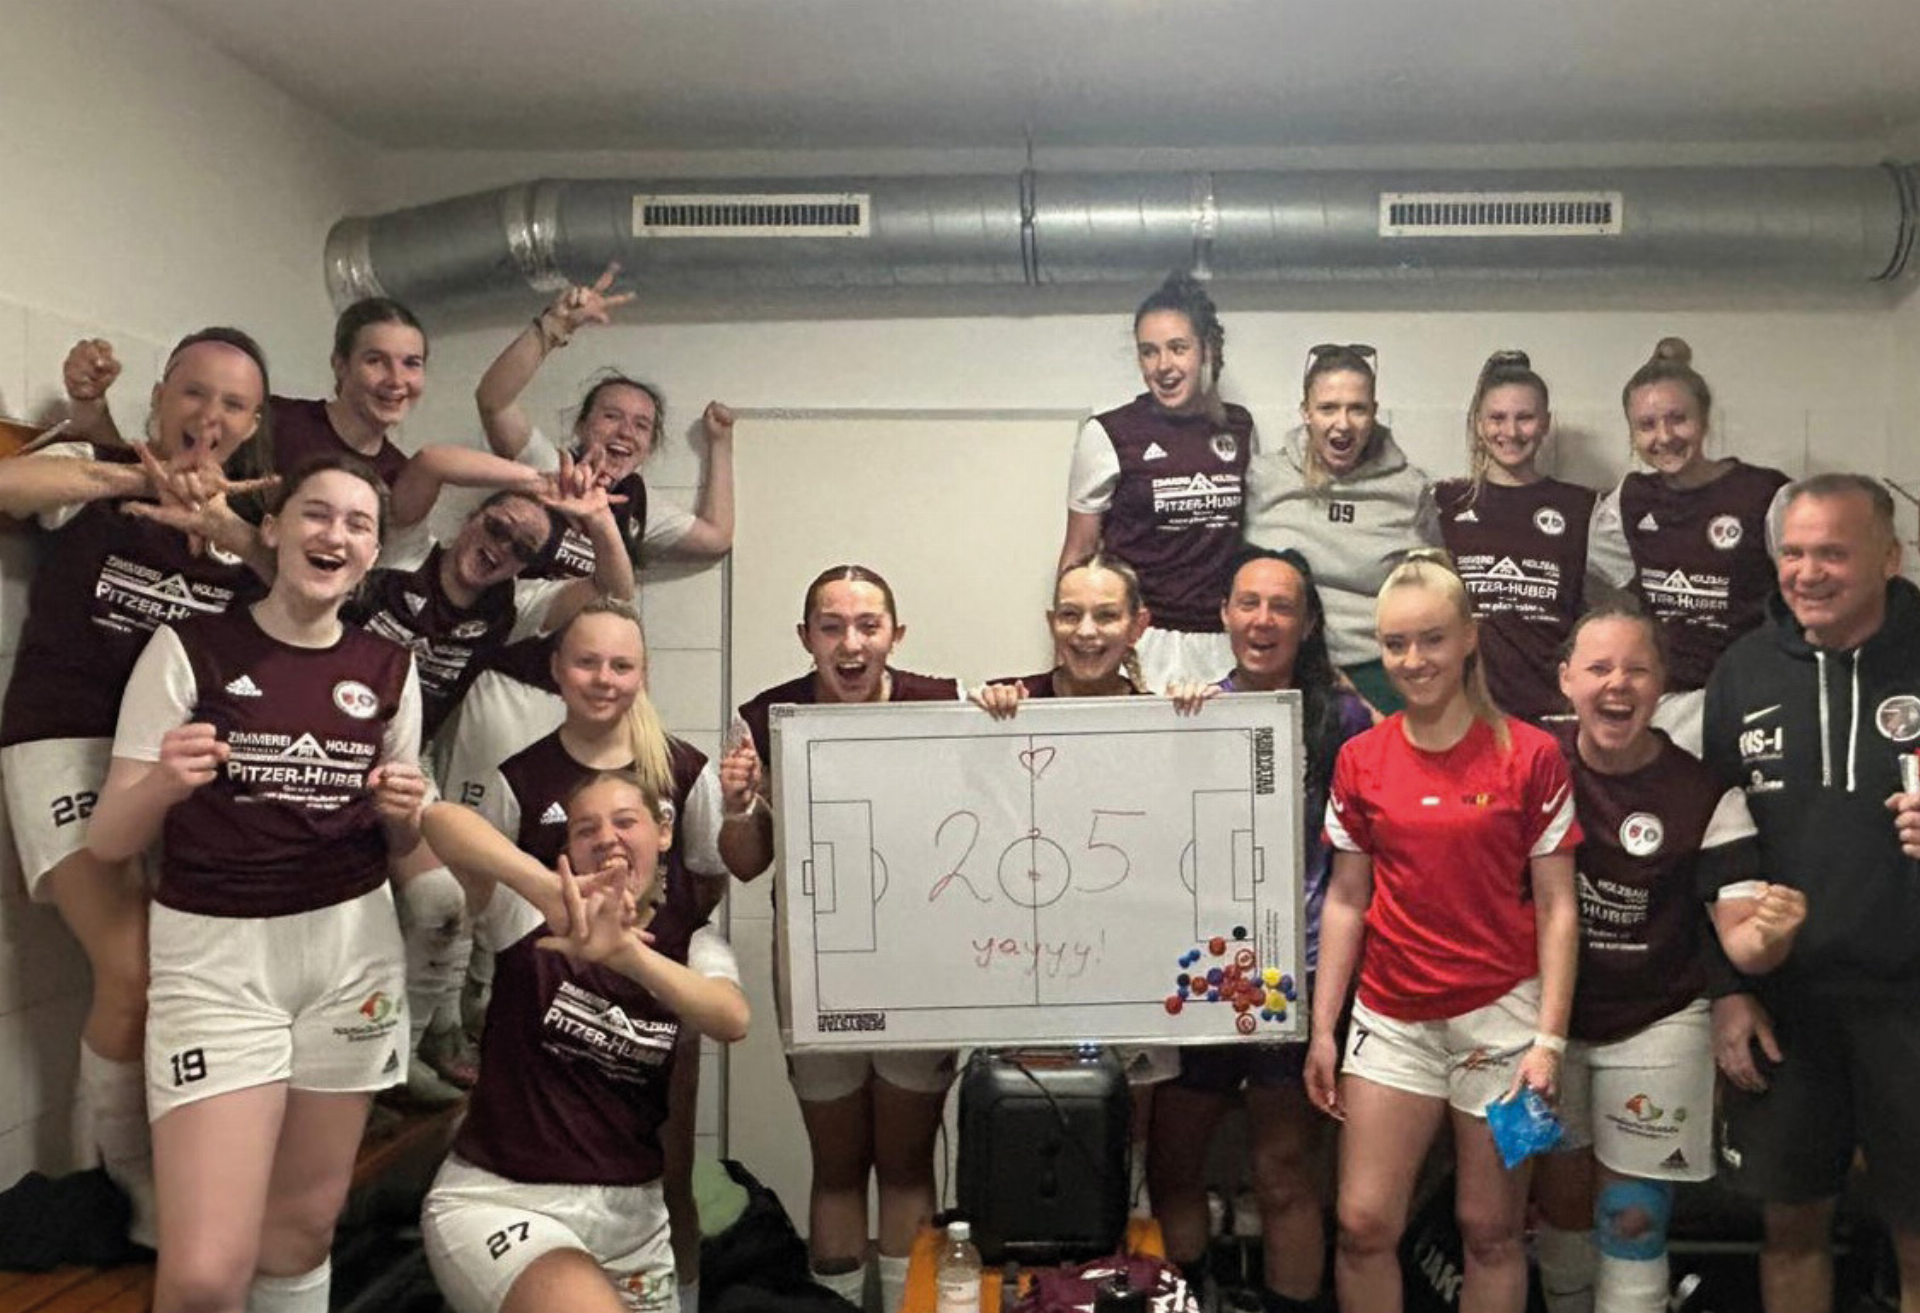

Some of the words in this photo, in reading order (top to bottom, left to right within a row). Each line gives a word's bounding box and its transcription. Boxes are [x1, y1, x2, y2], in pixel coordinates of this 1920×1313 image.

[1329, 503, 1355, 524] 09
[228, 731, 292, 746] ZIMMEREI
[325, 740, 376, 756] HOLZBAU
[227, 761, 363, 787] PITZER-HUBER
[51, 791, 99, 828] 22
[971, 928, 1106, 978] yayyy!
[1353, 1029, 1369, 1056] 7
[170, 1047, 207, 1088] 19
[486, 1221, 530, 1260] 27
